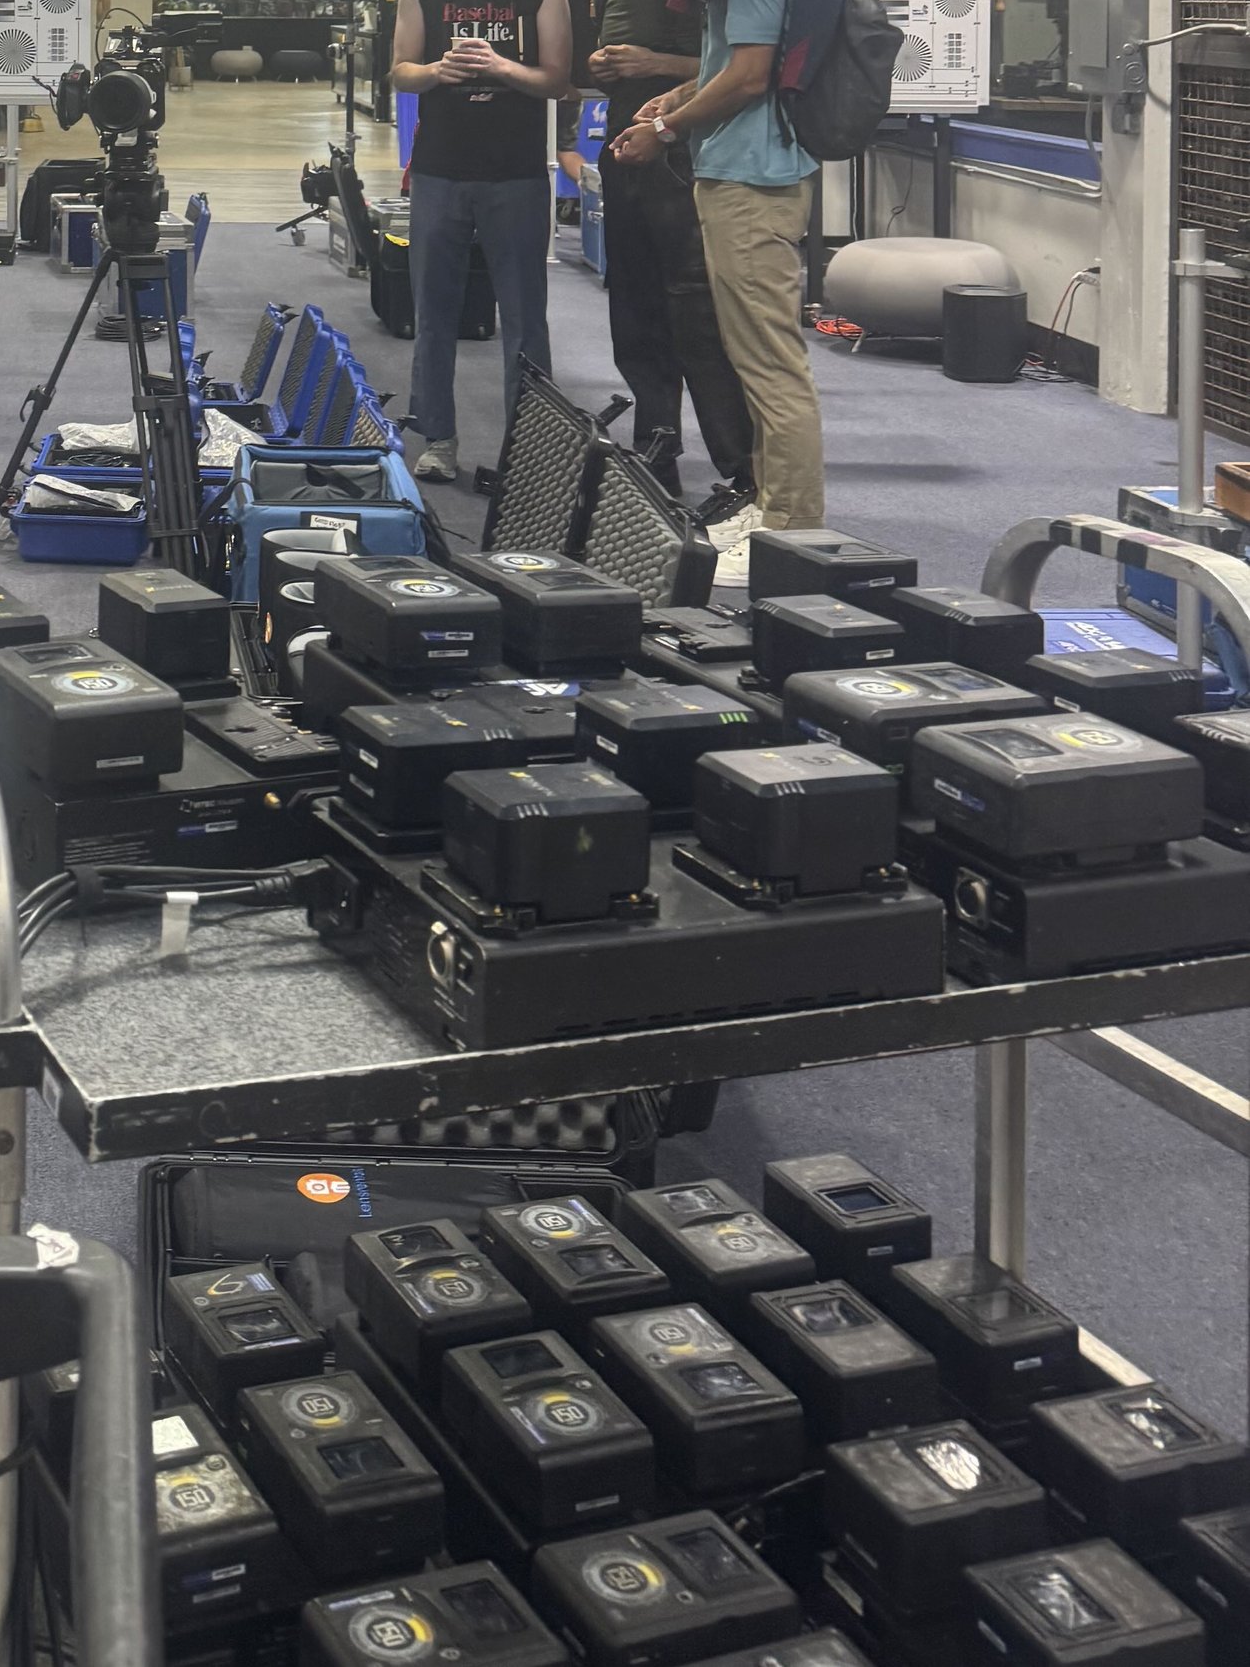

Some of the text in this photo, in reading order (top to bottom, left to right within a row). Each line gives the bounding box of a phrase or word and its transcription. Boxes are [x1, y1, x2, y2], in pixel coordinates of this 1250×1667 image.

[443, 2, 515, 22] Basebal
[452, 21, 469, 38] Is
[551, 1405, 586, 1423] 150
[175, 1488, 211, 1508] 150
